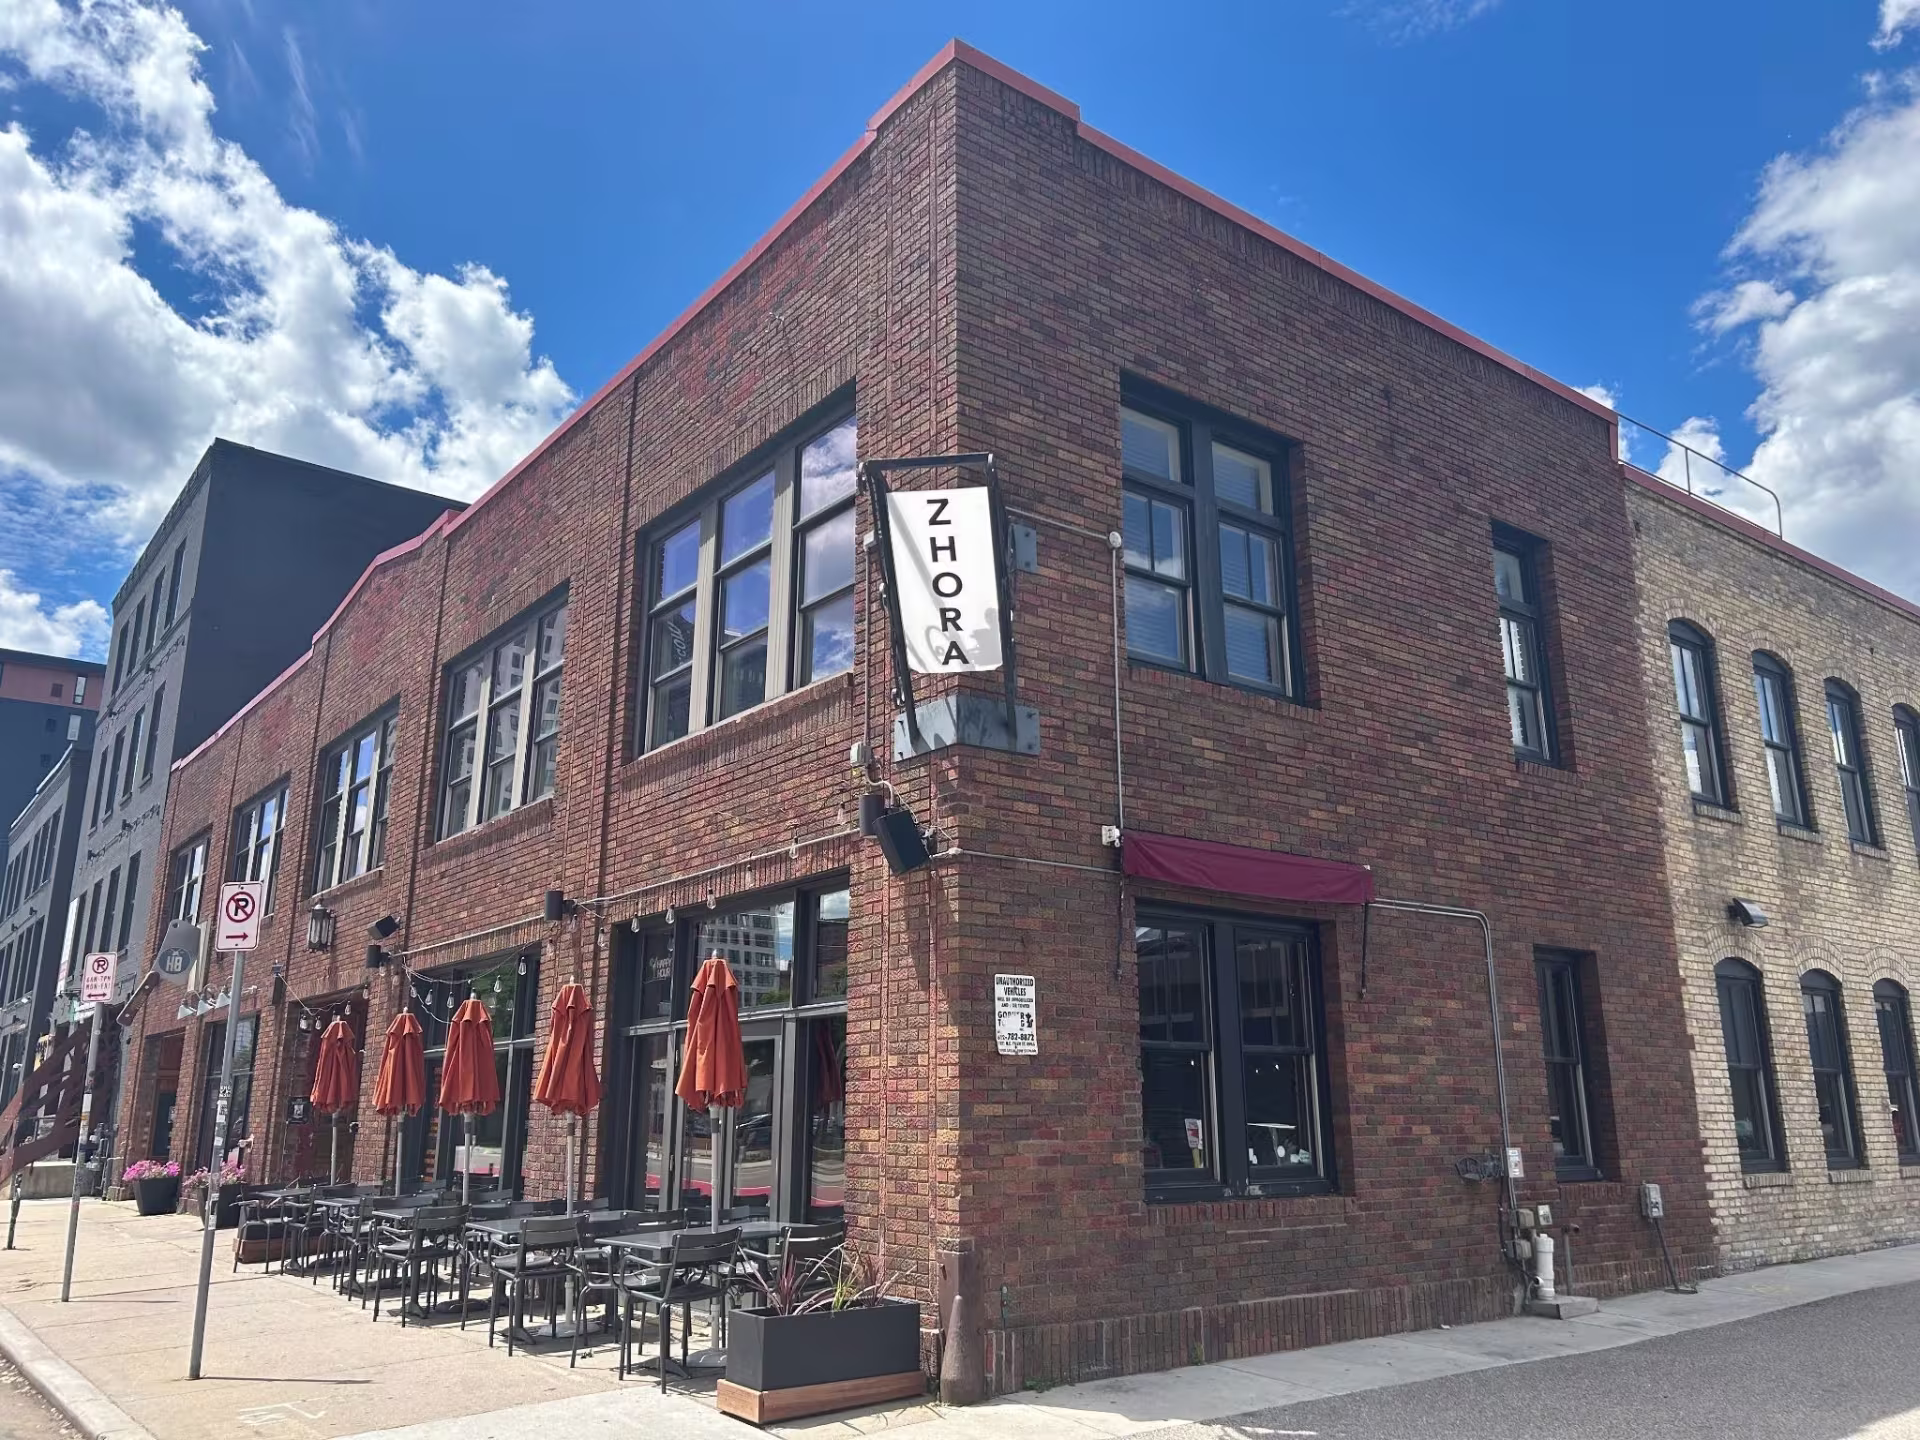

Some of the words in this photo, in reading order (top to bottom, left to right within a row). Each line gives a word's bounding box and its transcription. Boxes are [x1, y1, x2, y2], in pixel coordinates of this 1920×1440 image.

[926, 498, 969, 665] ZHORA
[166, 956, 182, 972] HB
[656, 957, 673, 968] HAPPY
[656, 968, 671, 978] HOUR
[996, 976, 1034, 986] UNAUTHORIZED
[1003, 986, 1027, 996] VEHICLES
